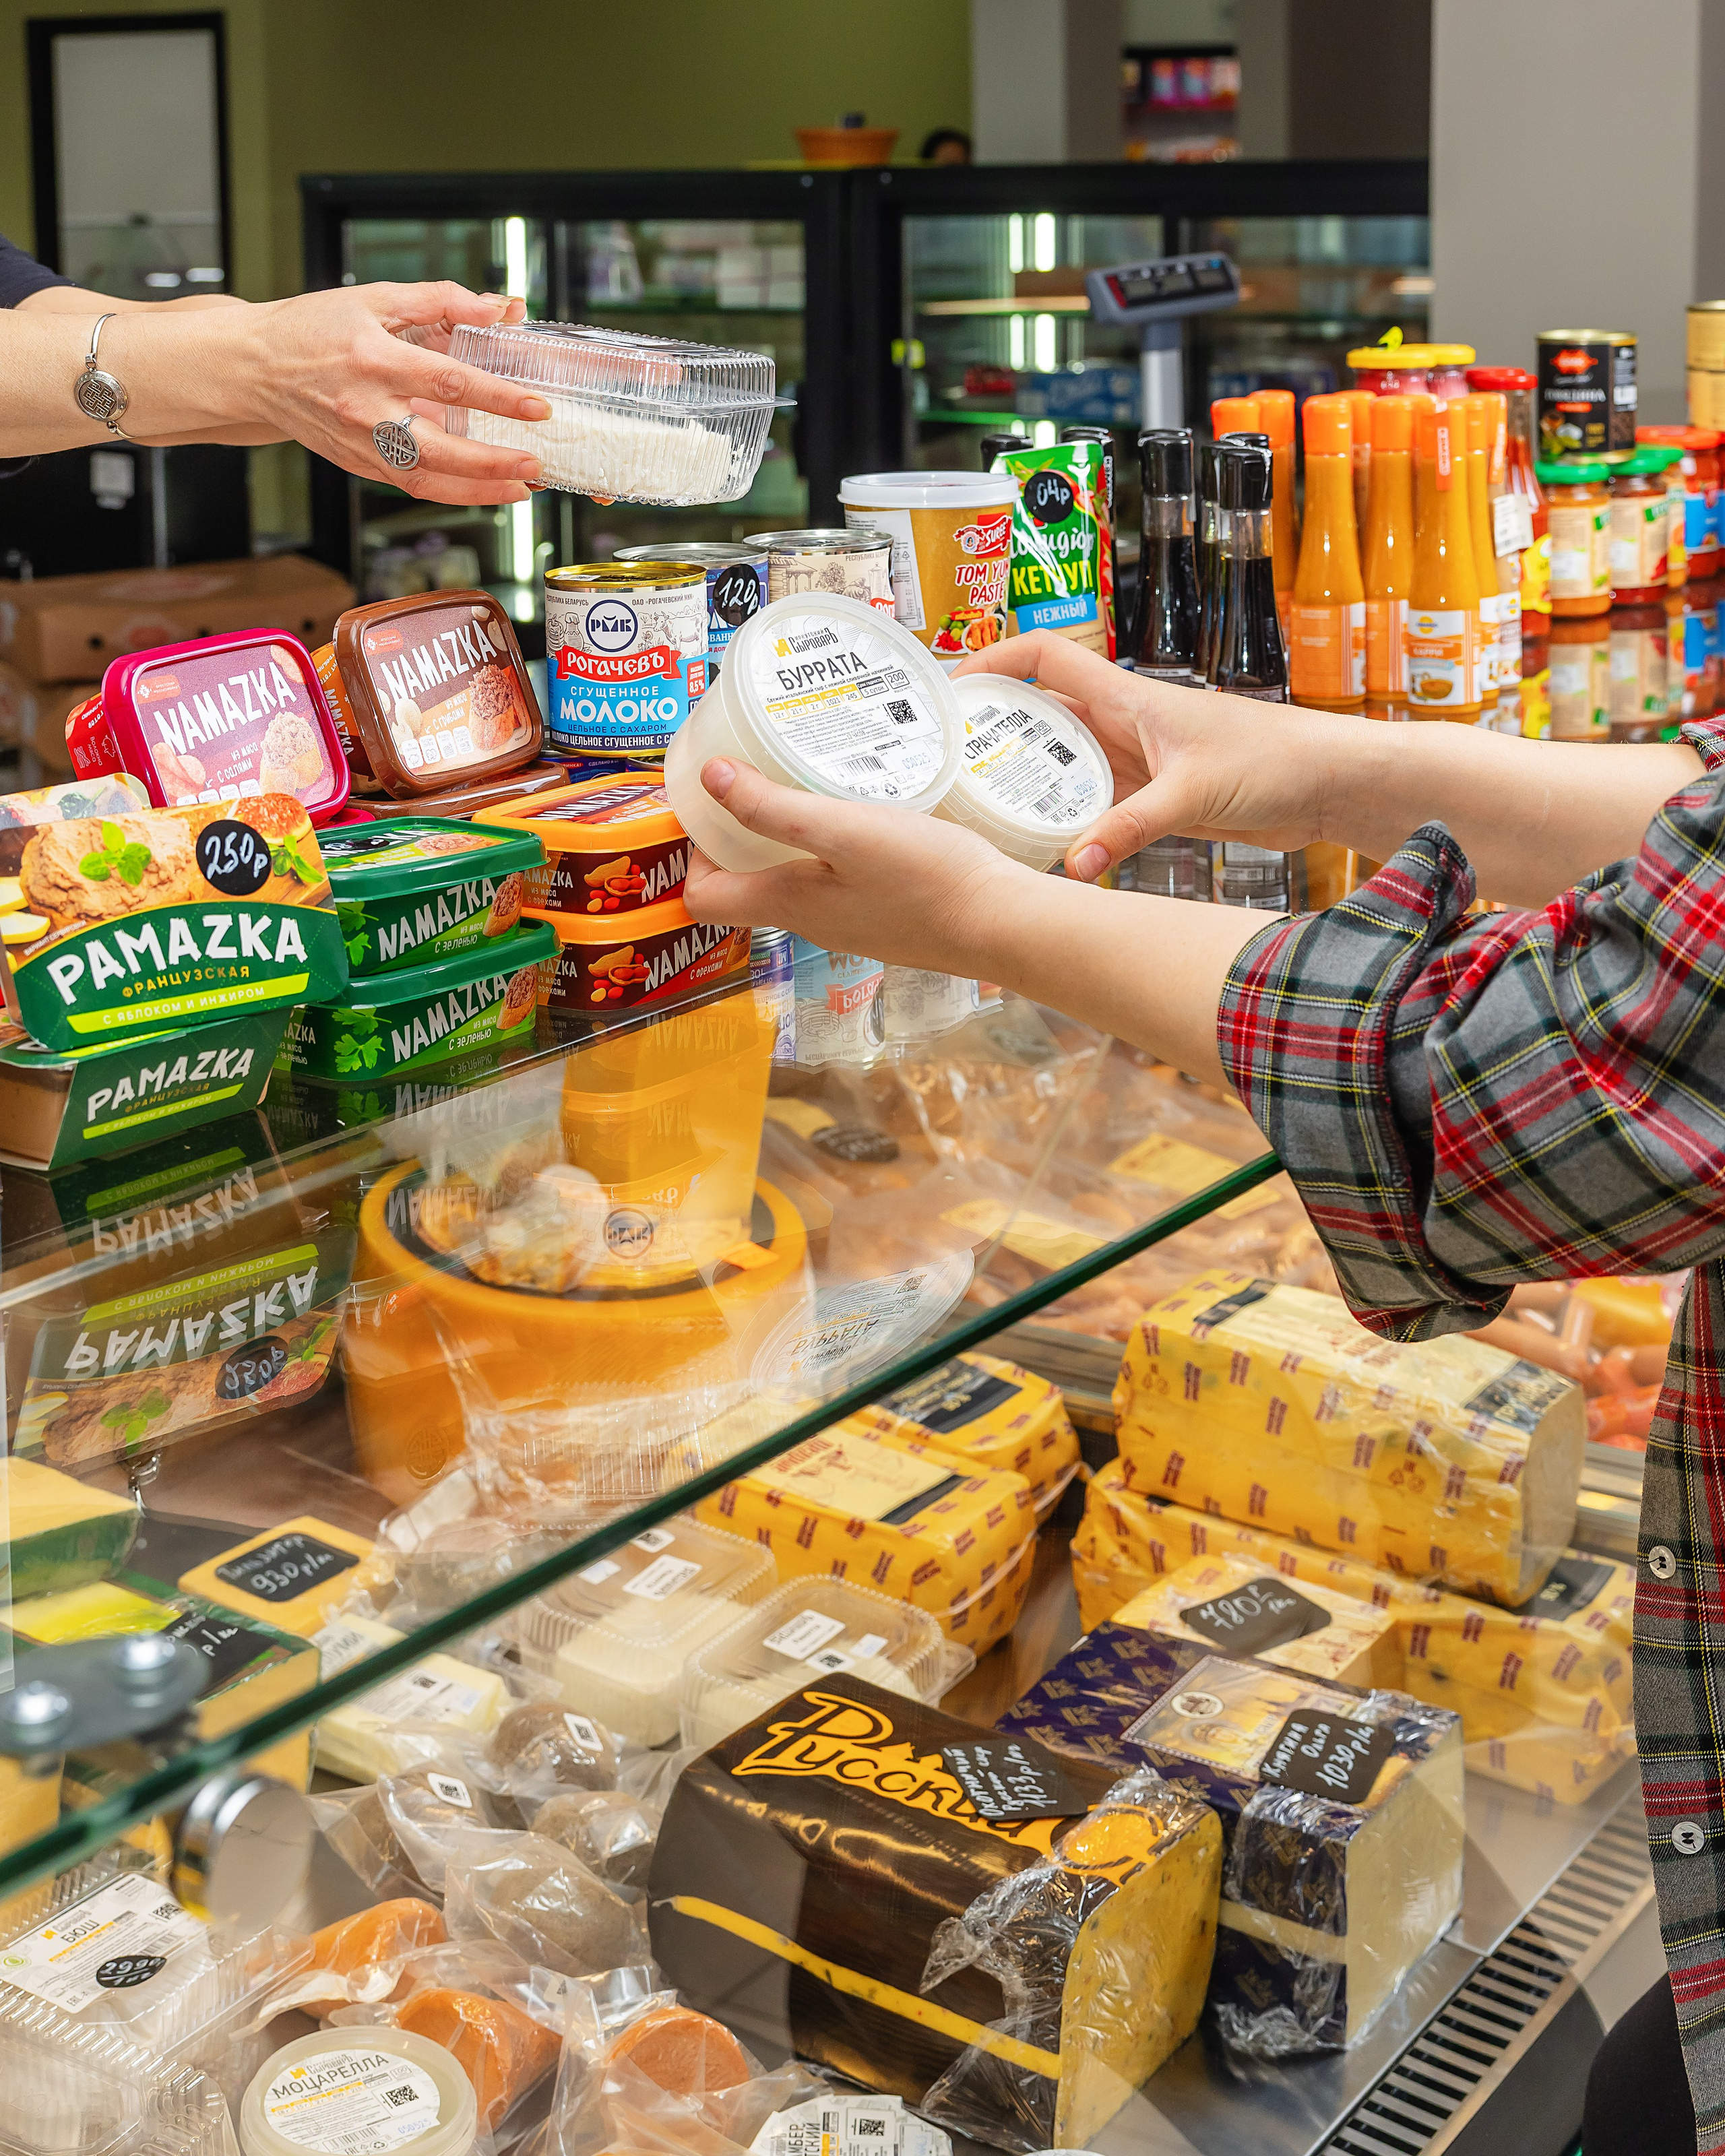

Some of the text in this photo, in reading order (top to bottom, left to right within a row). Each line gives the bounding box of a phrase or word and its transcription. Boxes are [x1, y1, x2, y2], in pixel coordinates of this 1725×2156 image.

[845, 552, 875, 561] РЕСПУБЛИКА
[956, 564, 988, 585] TOM
[565, 596, 589, 606] БЕЛАРУСЬ
[632, 598, 644, 606] ОАО
[719, 577, 759, 615] 120р
[970, 581, 1005, 605] PASTE
[1033, 597, 1088, 625] НЕЖНЫЙ
[379, 619, 498, 704] NAMAZKA
[567, 653, 665, 676] РОГАЧЕВЪ
[776, 652, 868, 691] БУРРАТА
[570, 685, 659, 697] СГУЩЕННОЕ
[689, 680, 705, 694] 8,5%
[767, 694, 785, 703] Свежий
[785, 687, 814, 699] итальянский
[814, 685, 824, 693] сыр
[827, 678, 846, 689] нежной
[846, 671, 871, 685] сливочной
[871, 664, 894, 677] начинкой
[870, 686, 885, 695] суток
[887, 672, 905, 684] 200
[153, 662, 298, 756] NAMAZKA
[559, 697, 679, 724] МОЛОКО
[826, 698, 841, 706] 1021
[568, 723, 667, 733] ЦЕЛЬНОЕ С САХАРОМ
[1036, 722, 1047, 731] 250
[570, 734, 603, 746] ЦЕЛЬНОЕ
[604, 734, 655, 749] СГУЩЕННОЕ
[656, 734, 663, 744] С
[902, 753, 931, 769] 050525
[1073, 778, 1098, 796] 050525
[205, 831, 268, 879] 250р
[377, 877, 498, 962] NAMAZKA
[46, 912, 309, 1007] PAMAZKA
[644, 923, 737, 992] NAMAZK
[121, 964, 251, 999] ФРАНЦУЗСКАЯ
[103, 985, 265, 1025] С ЯБЛОКОМ И ИНЖИРОМ
[391, 974, 509, 1064] NAMAZKA
[86, 1048, 255, 1122] PAMAZKA
[125, 1082, 210, 1114] ФРАНЦУЗСКАЯ
[734, 1691, 1035, 1838] Русск
[61, 1919, 100, 1944] БЮШ
[272, 2054, 389, 2099] МОЦАРЕЛЛА
[398, 2118, 433, 2134] 050525
